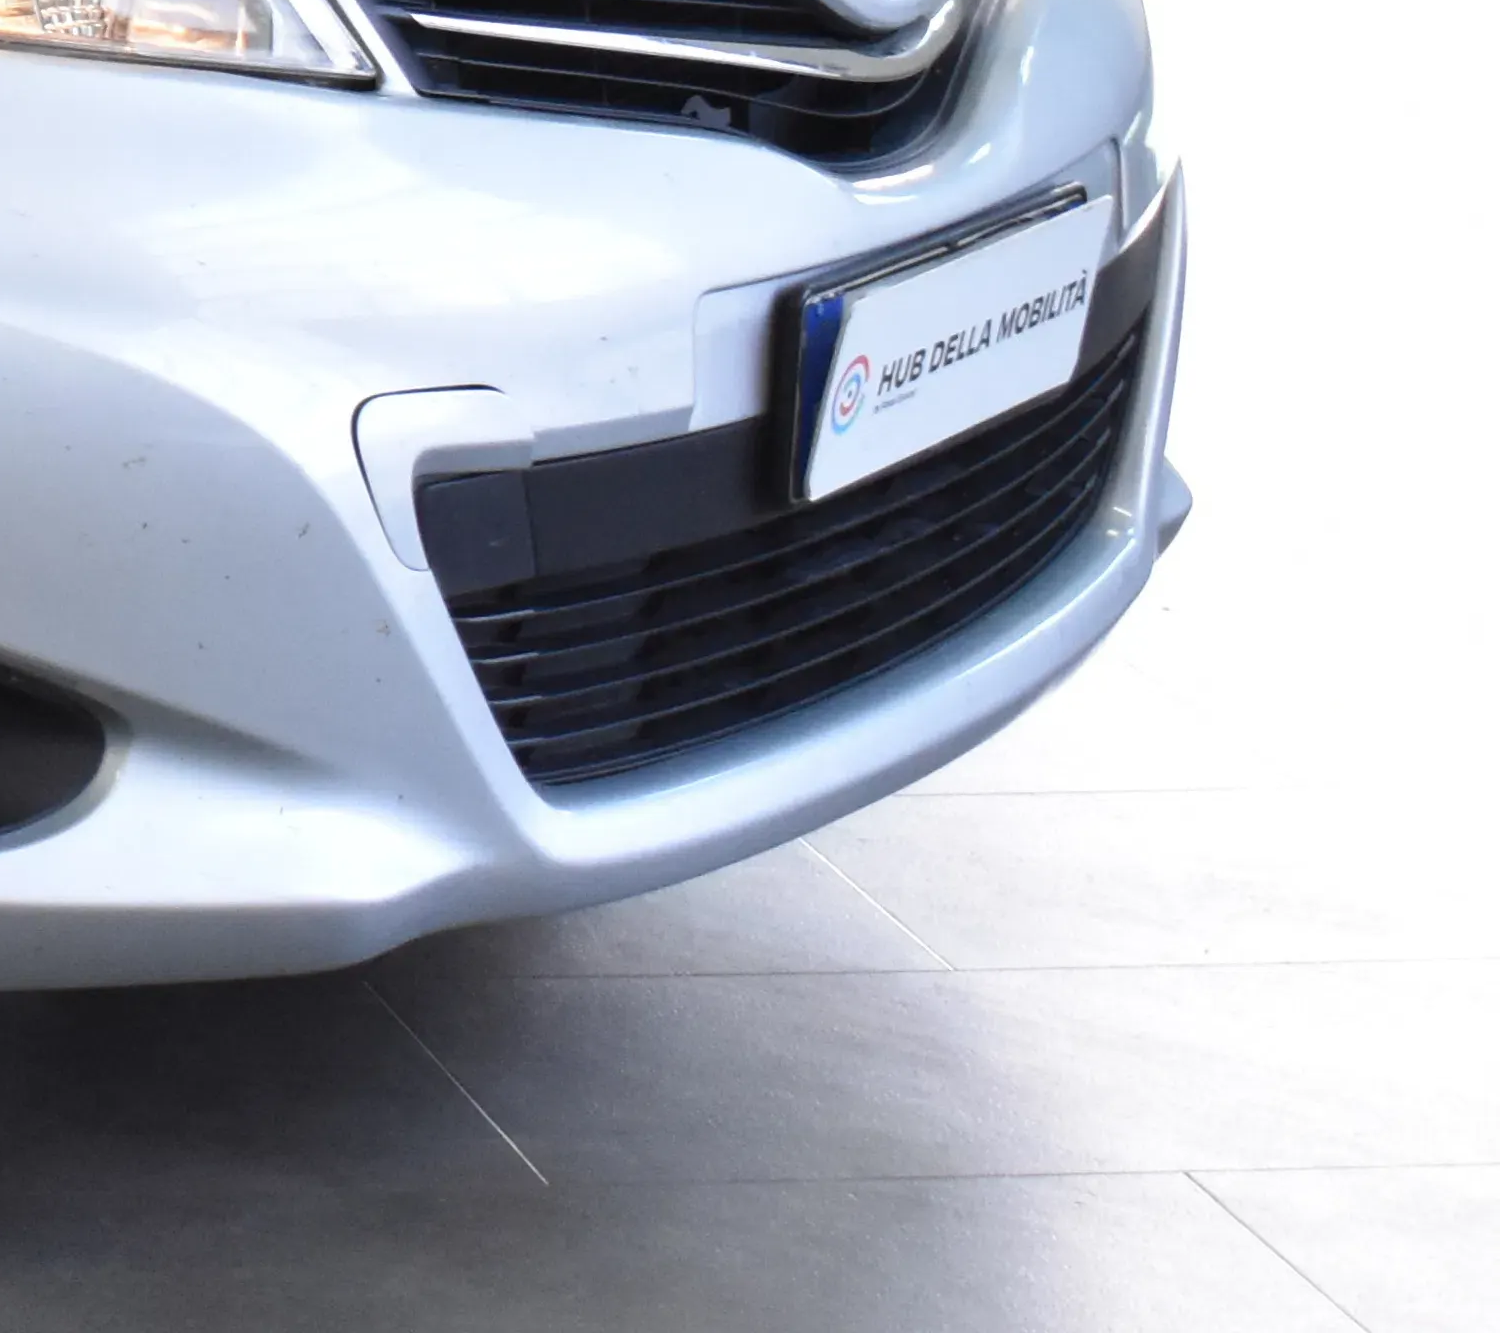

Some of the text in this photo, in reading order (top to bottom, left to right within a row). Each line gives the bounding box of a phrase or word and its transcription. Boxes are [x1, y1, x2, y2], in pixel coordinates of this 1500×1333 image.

[877, 269, 1088, 396] HUB DELLA MOBILITÀ
